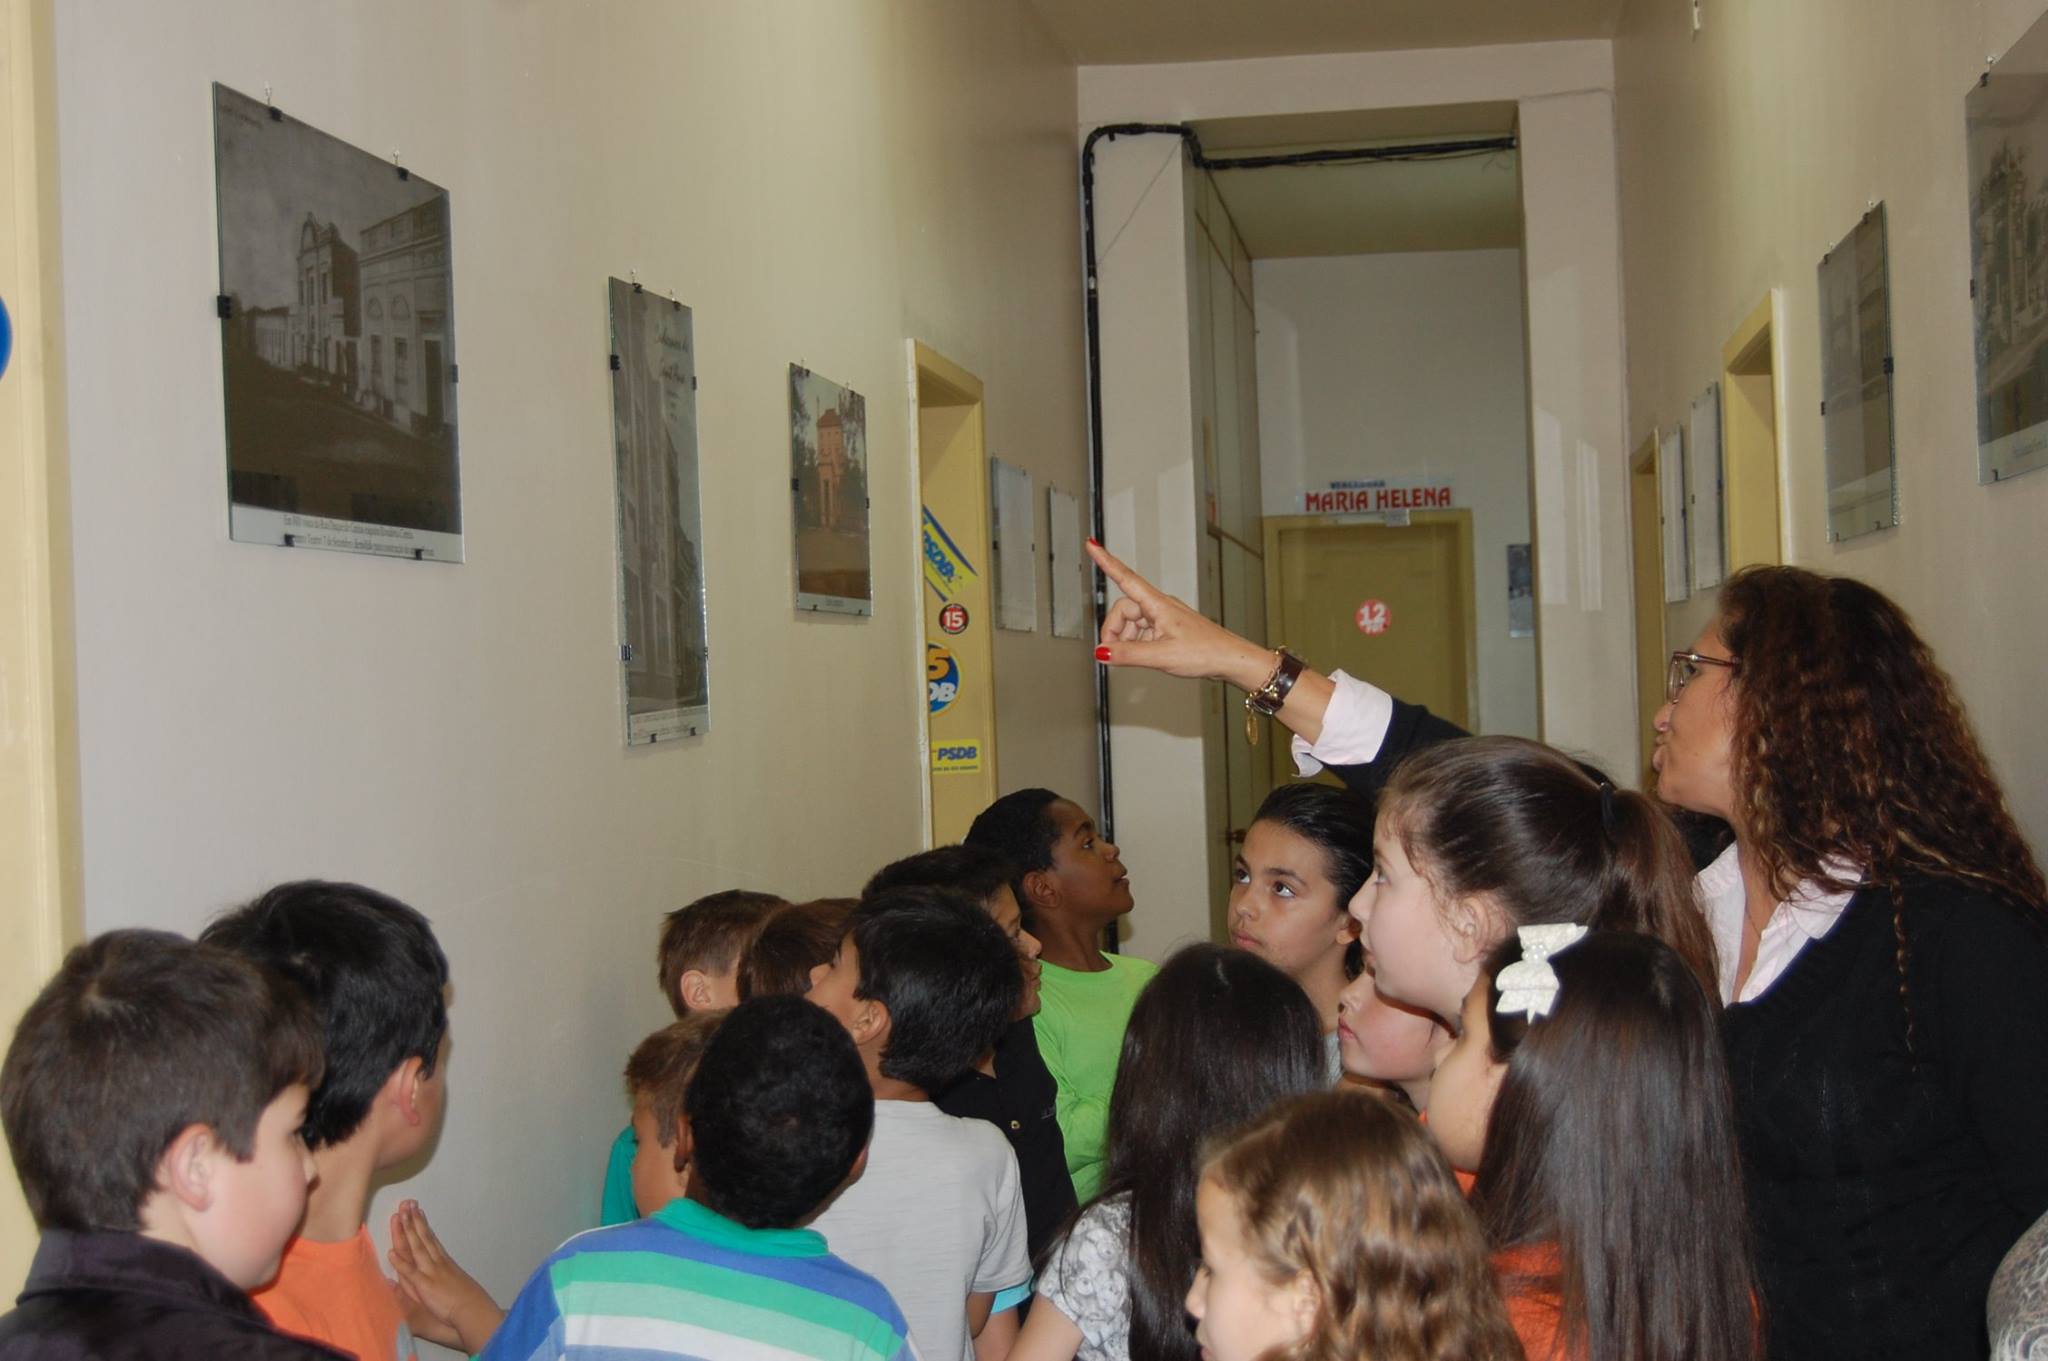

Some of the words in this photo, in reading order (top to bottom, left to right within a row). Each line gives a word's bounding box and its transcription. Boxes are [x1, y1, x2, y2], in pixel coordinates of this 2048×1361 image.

[1305, 491, 1369, 512] MARIA
[1375, 487, 1452, 510] HELENA
[944, 612, 963, 628] 15
[1359, 602, 1386, 626] 12
[928, 648, 950, 676] 5
[937, 746, 977, 761] PSDB
